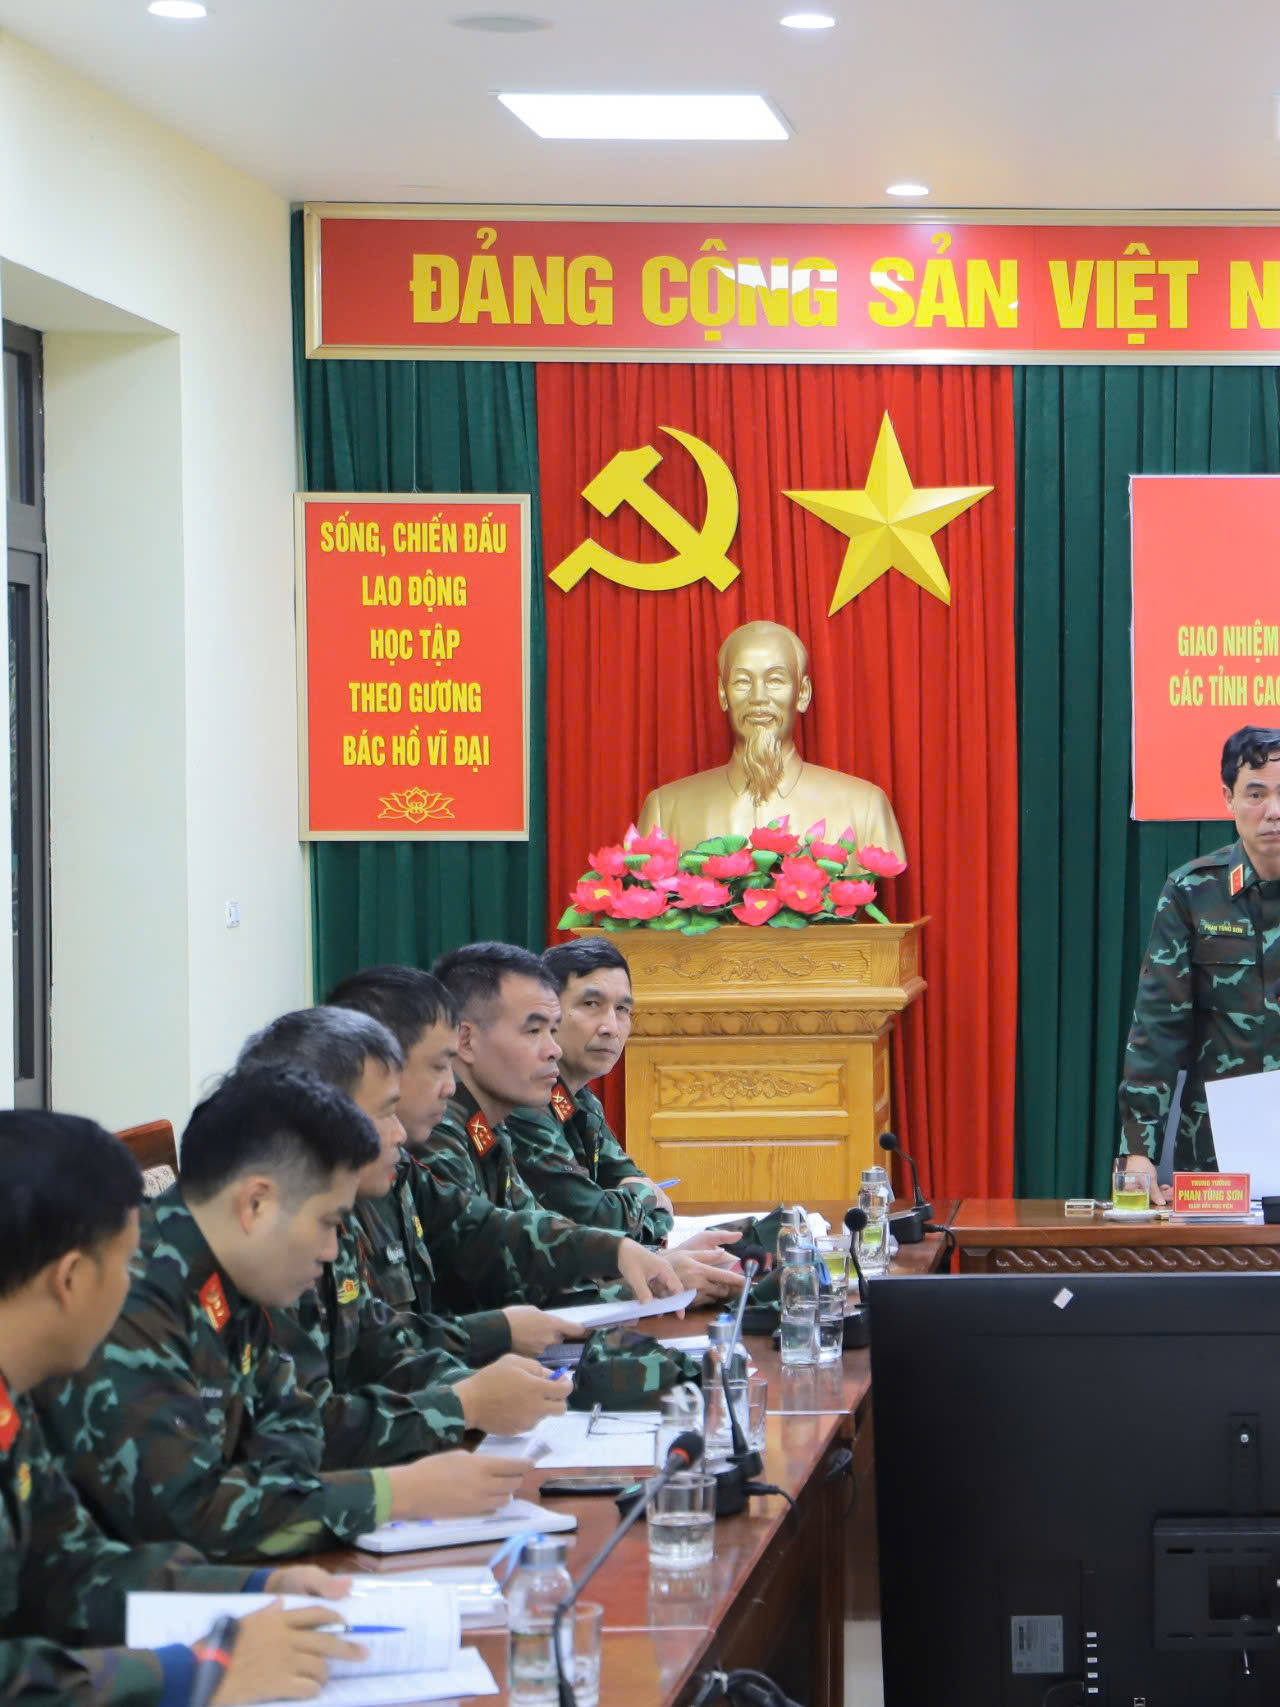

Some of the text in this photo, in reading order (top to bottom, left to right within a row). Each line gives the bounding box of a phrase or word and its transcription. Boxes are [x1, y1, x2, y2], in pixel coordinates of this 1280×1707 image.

[410, 227, 614, 326] ĐẢNG
[642, 238, 840, 343] CỘNG
[868, 232, 1019, 329] SẢN
[1049, 242, 1199, 345] VIỆT
[320, 511, 507, 556] SỐNG, CHIẾN ĐẤU
[361, 569, 467, 612] LAO ĐỘNG
[370, 624, 461, 667] HỌC TẬP
[1178, 626, 1218, 657] GIAO
[1223, 619, 1279, 663] NHIỆM
[349, 679, 482, 713] THEO GƯƠNG
[1169, 670, 1203, 707] CÁC
[1208, 665, 1248, 707] TỈNH
[342, 725, 490, 773] BÁC HỒ VĨ ĐẠI
[1178, 1190, 1201, 1201] PHAN
